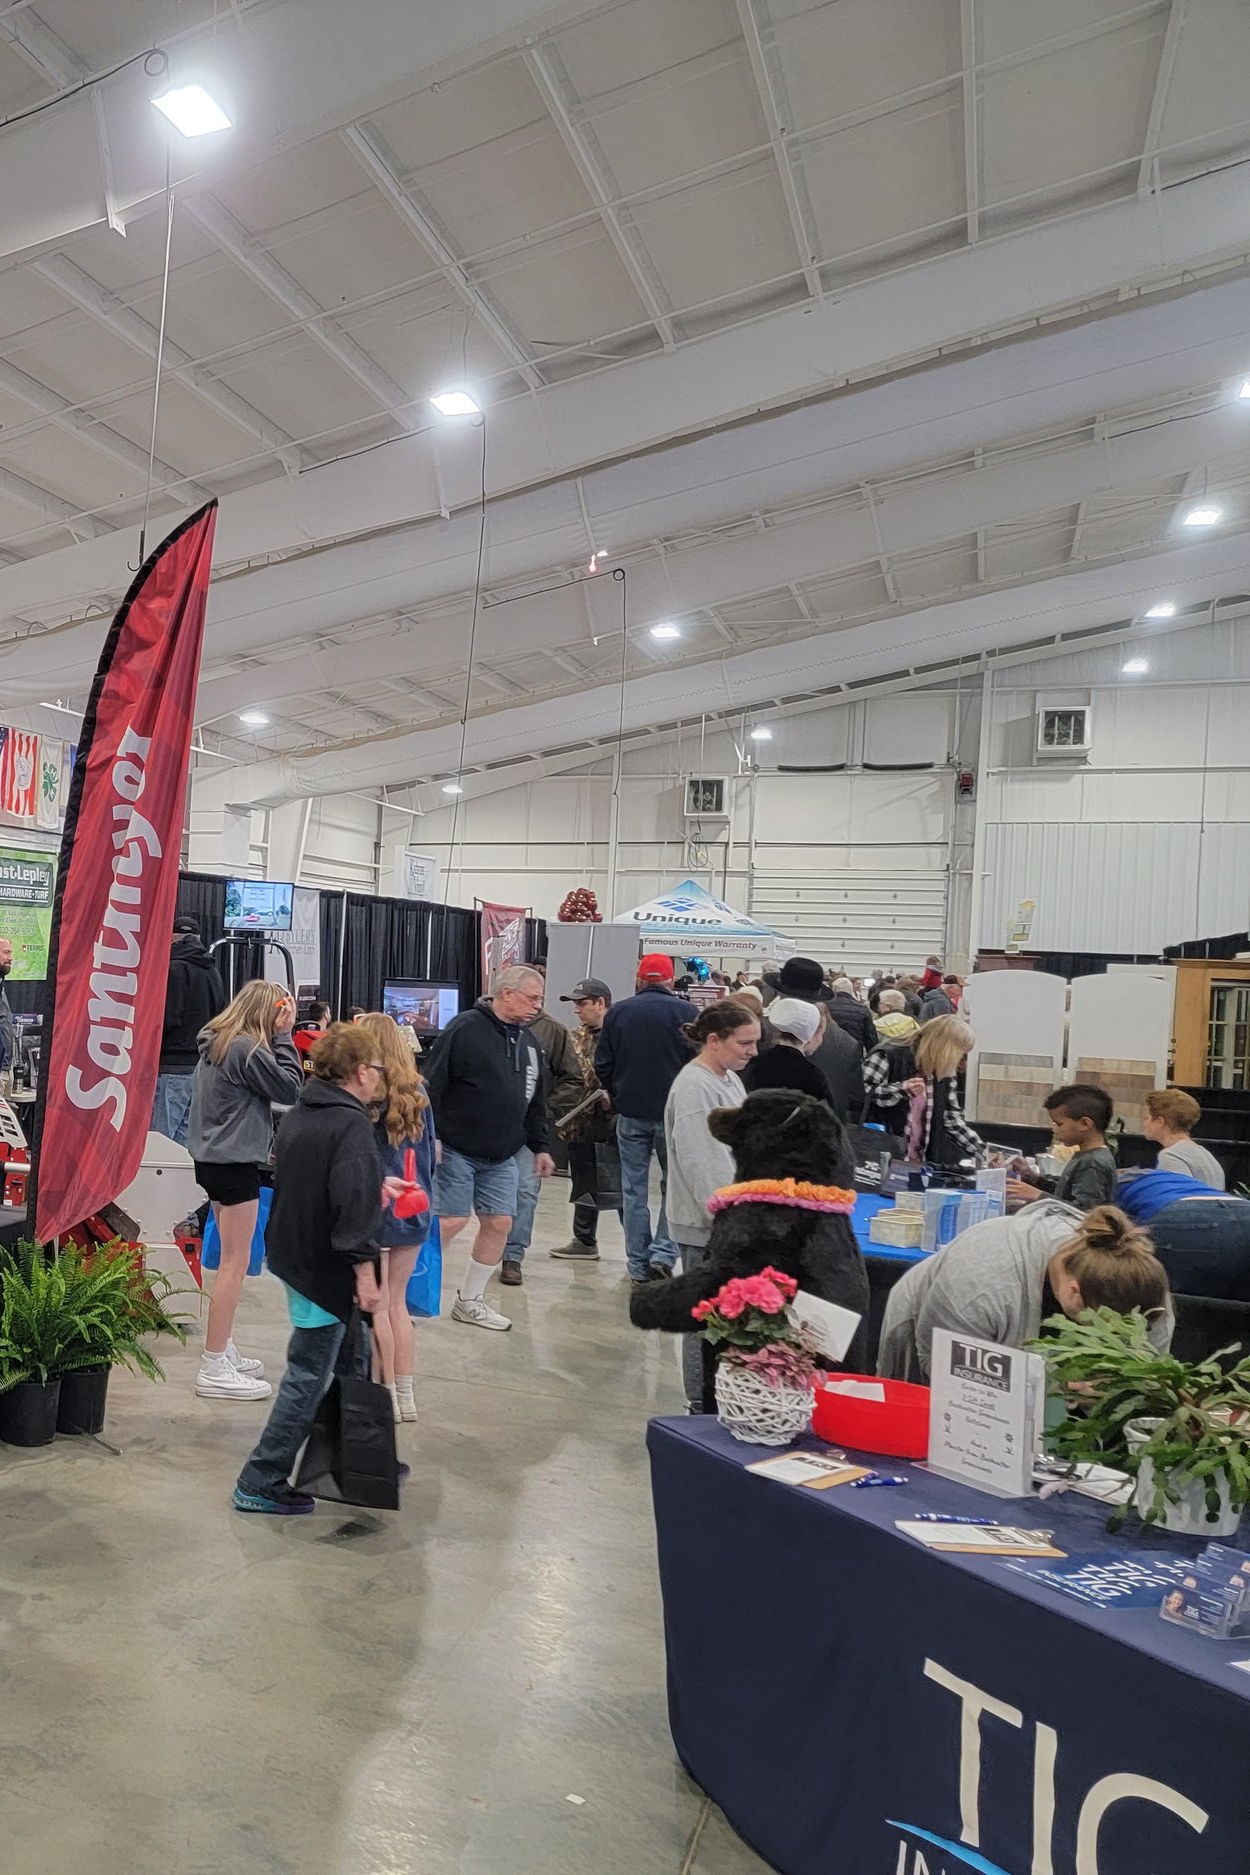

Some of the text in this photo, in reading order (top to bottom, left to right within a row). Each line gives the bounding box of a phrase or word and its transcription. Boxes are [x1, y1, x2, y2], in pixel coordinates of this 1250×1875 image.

[65, 722, 162, 1132] Santmyer
[633, 911, 722, 926] Unique
[644, 937, 758, 950] Famous Unique Warranty
[959, 1343, 1003, 1377] TIG
[953, 1366, 1009, 1391] INSURANCE
